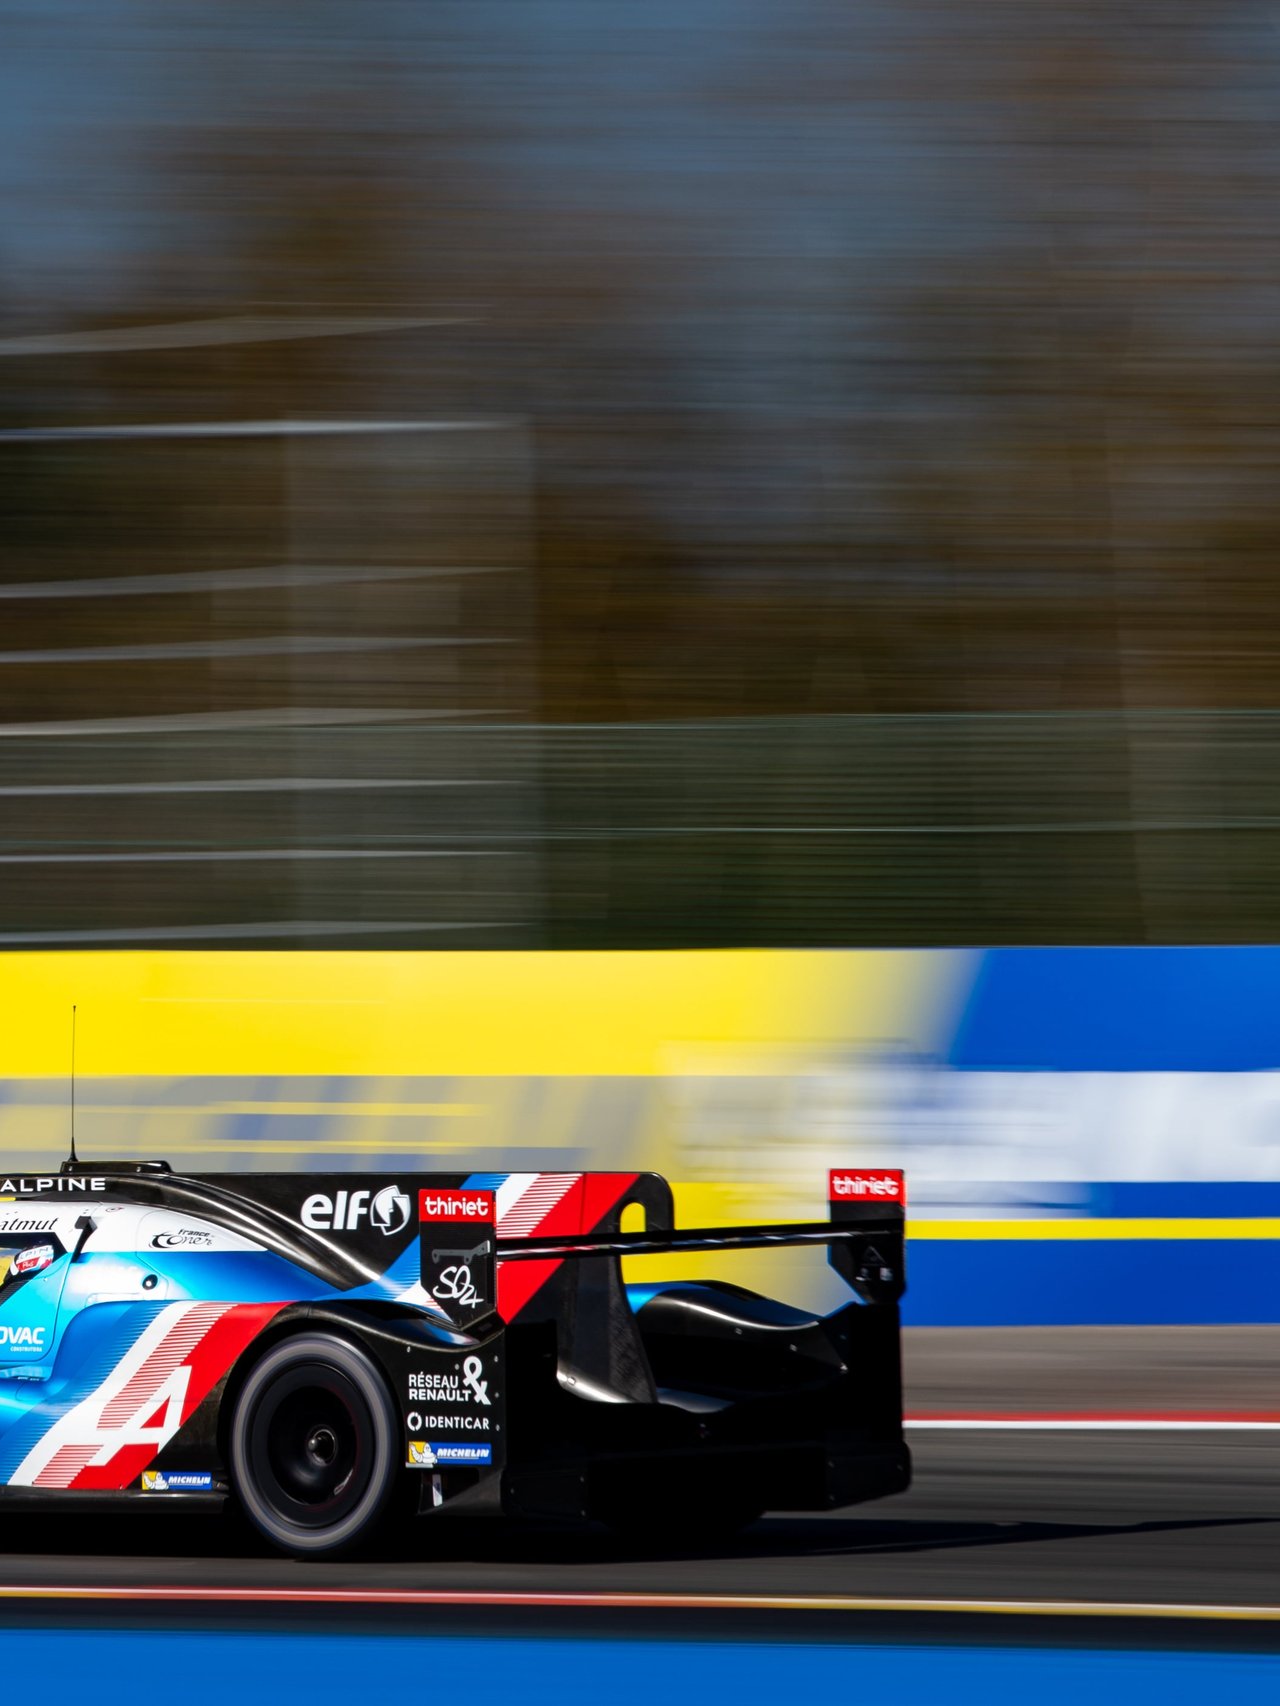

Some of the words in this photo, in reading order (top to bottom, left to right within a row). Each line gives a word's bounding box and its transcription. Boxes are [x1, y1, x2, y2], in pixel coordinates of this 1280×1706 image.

[0, 1178, 106, 1192] ALPINE
[832, 1176, 899, 1195] thiriet
[301, 1191, 370, 1230] elf
[425, 1196, 488, 1216] thiriet
[408, 1371, 458, 1388] RÉSEAU
[409, 1388, 471, 1401] RENAULT
[425, 1416, 490, 1430] IDENTICAR
[437, 1448, 490, 1457] MICHELIN
[168, 1476, 211, 1484] MICHELIN
